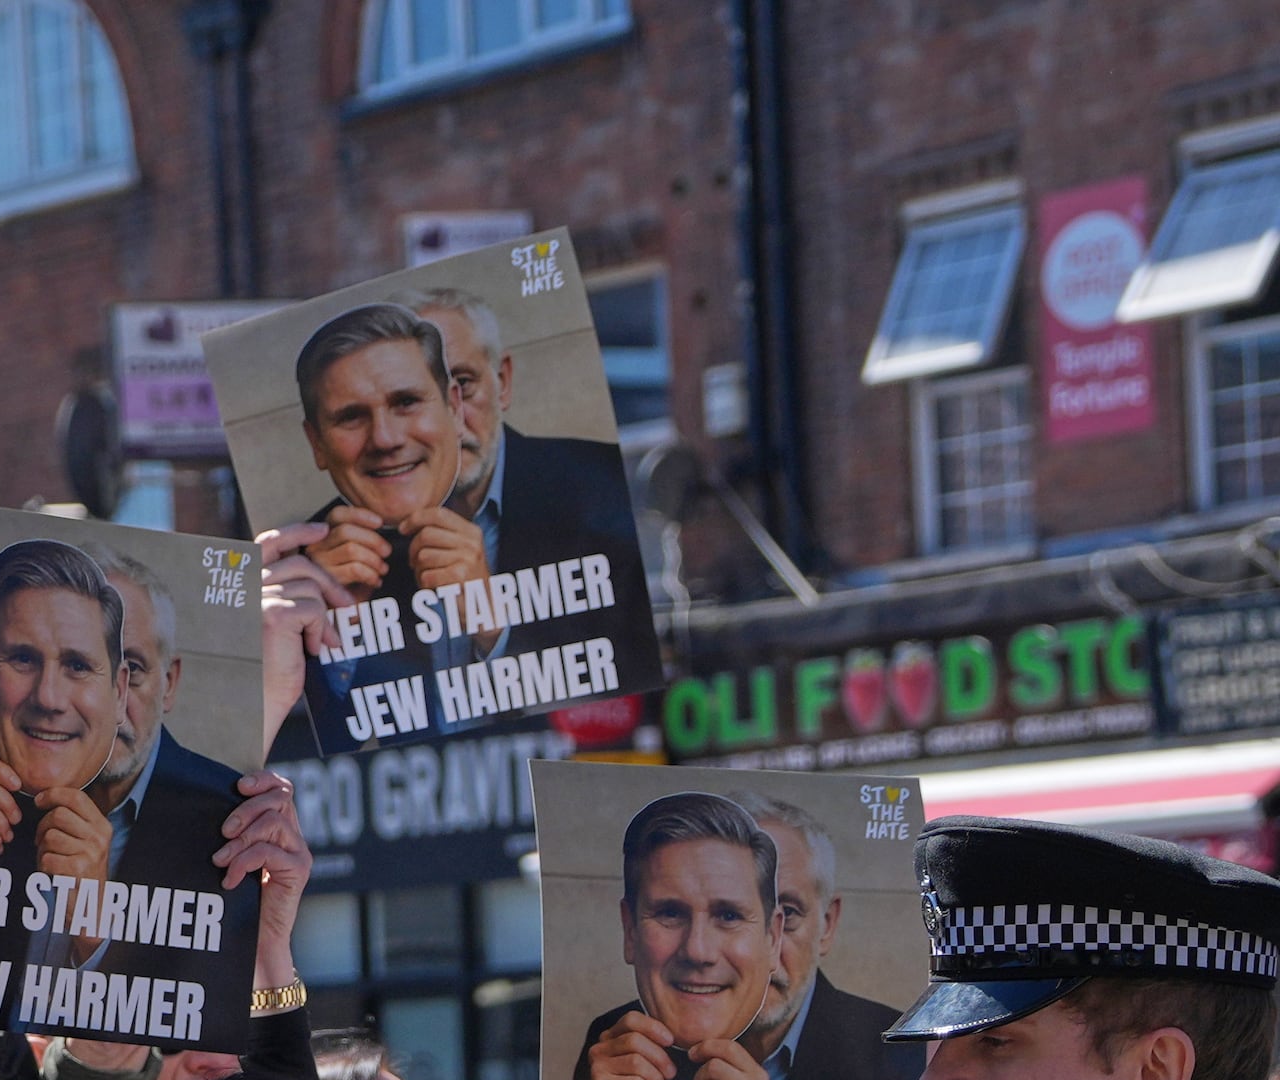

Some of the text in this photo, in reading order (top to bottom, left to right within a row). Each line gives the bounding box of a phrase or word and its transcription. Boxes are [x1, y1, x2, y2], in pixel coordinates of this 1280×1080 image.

[520, 256, 558, 279] THE
[520, 272, 565, 298] HATE
[207, 566, 245, 589] THE
[202, 585, 246, 609] HATE
[410, 552, 617, 645] STARMER
[344, 636, 620, 743] JEW HARMER
[868, 802, 905, 822] THE
[865, 820, 911, 841] HATE
[20, 872, 226, 954] STARMER
[17, 966, 206, 1042] HARMER
